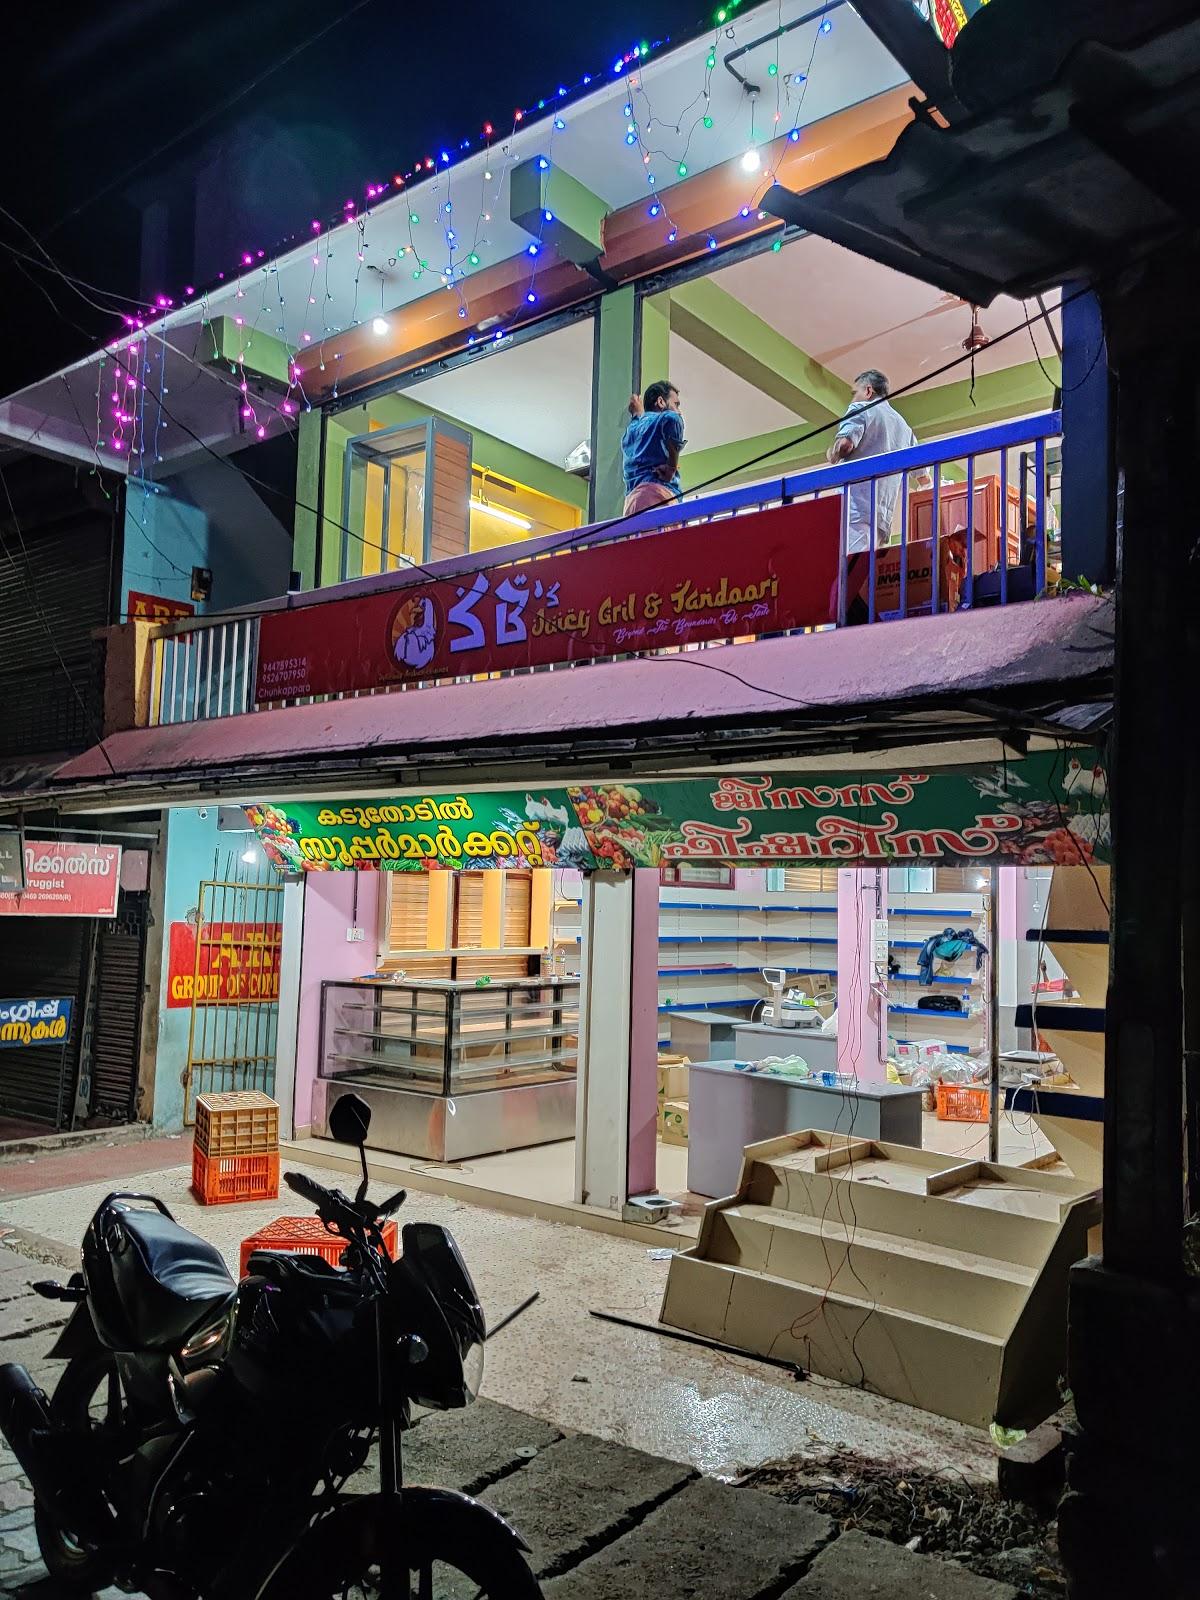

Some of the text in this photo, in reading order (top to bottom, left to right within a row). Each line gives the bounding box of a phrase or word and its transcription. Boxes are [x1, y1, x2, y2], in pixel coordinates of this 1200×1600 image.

[532, 608, 590, 638] Juicy
[598, 592, 635, 625] Gril
[643, 593, 663, 619] &
[262, 668, 306, 684] 9526707950
[171, 974, 223, 1000] GROUP
[226, 973, 246, 997] OF
